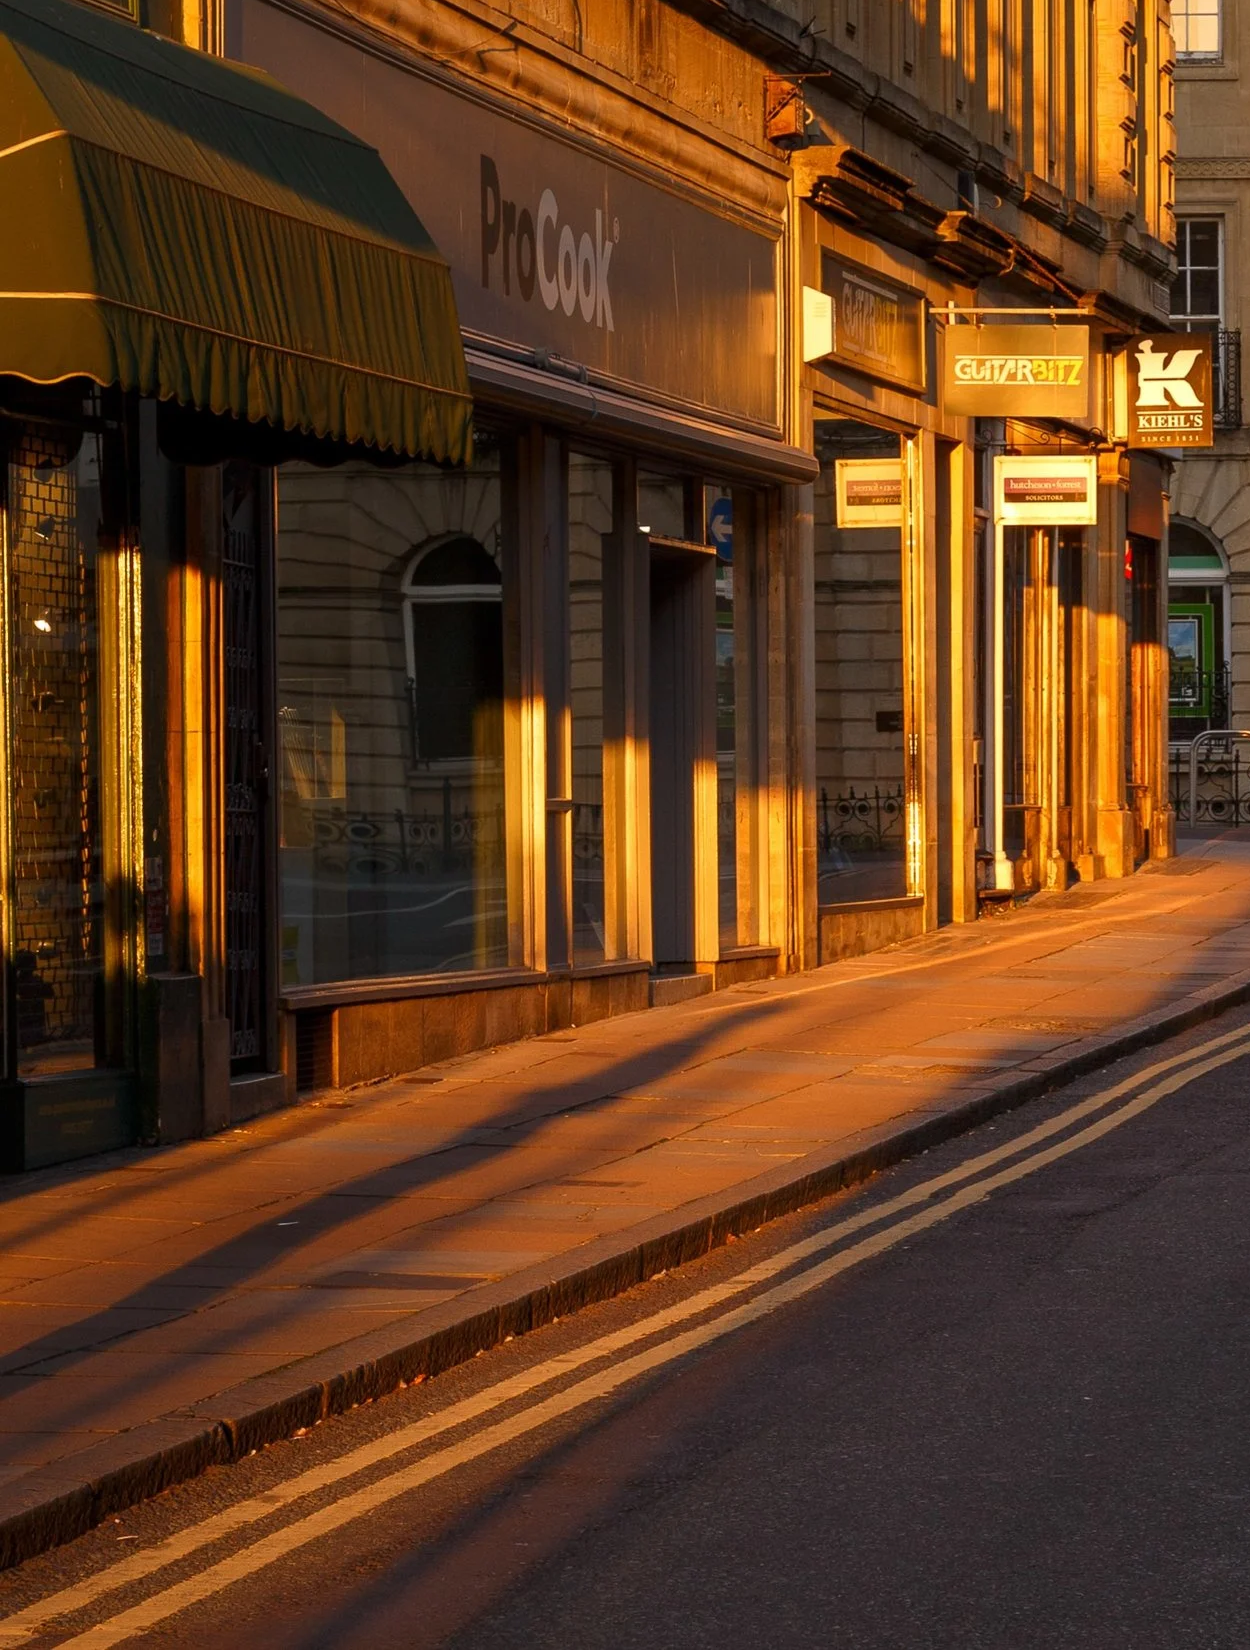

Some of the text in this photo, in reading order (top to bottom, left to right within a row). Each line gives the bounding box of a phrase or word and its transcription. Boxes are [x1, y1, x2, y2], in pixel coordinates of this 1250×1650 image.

[954, 358, 1084, 386] GUITARBITZ
[1138, 414, 1204, 429] KIEHL'S
[1141, 435, 1172, 443] SINCE
